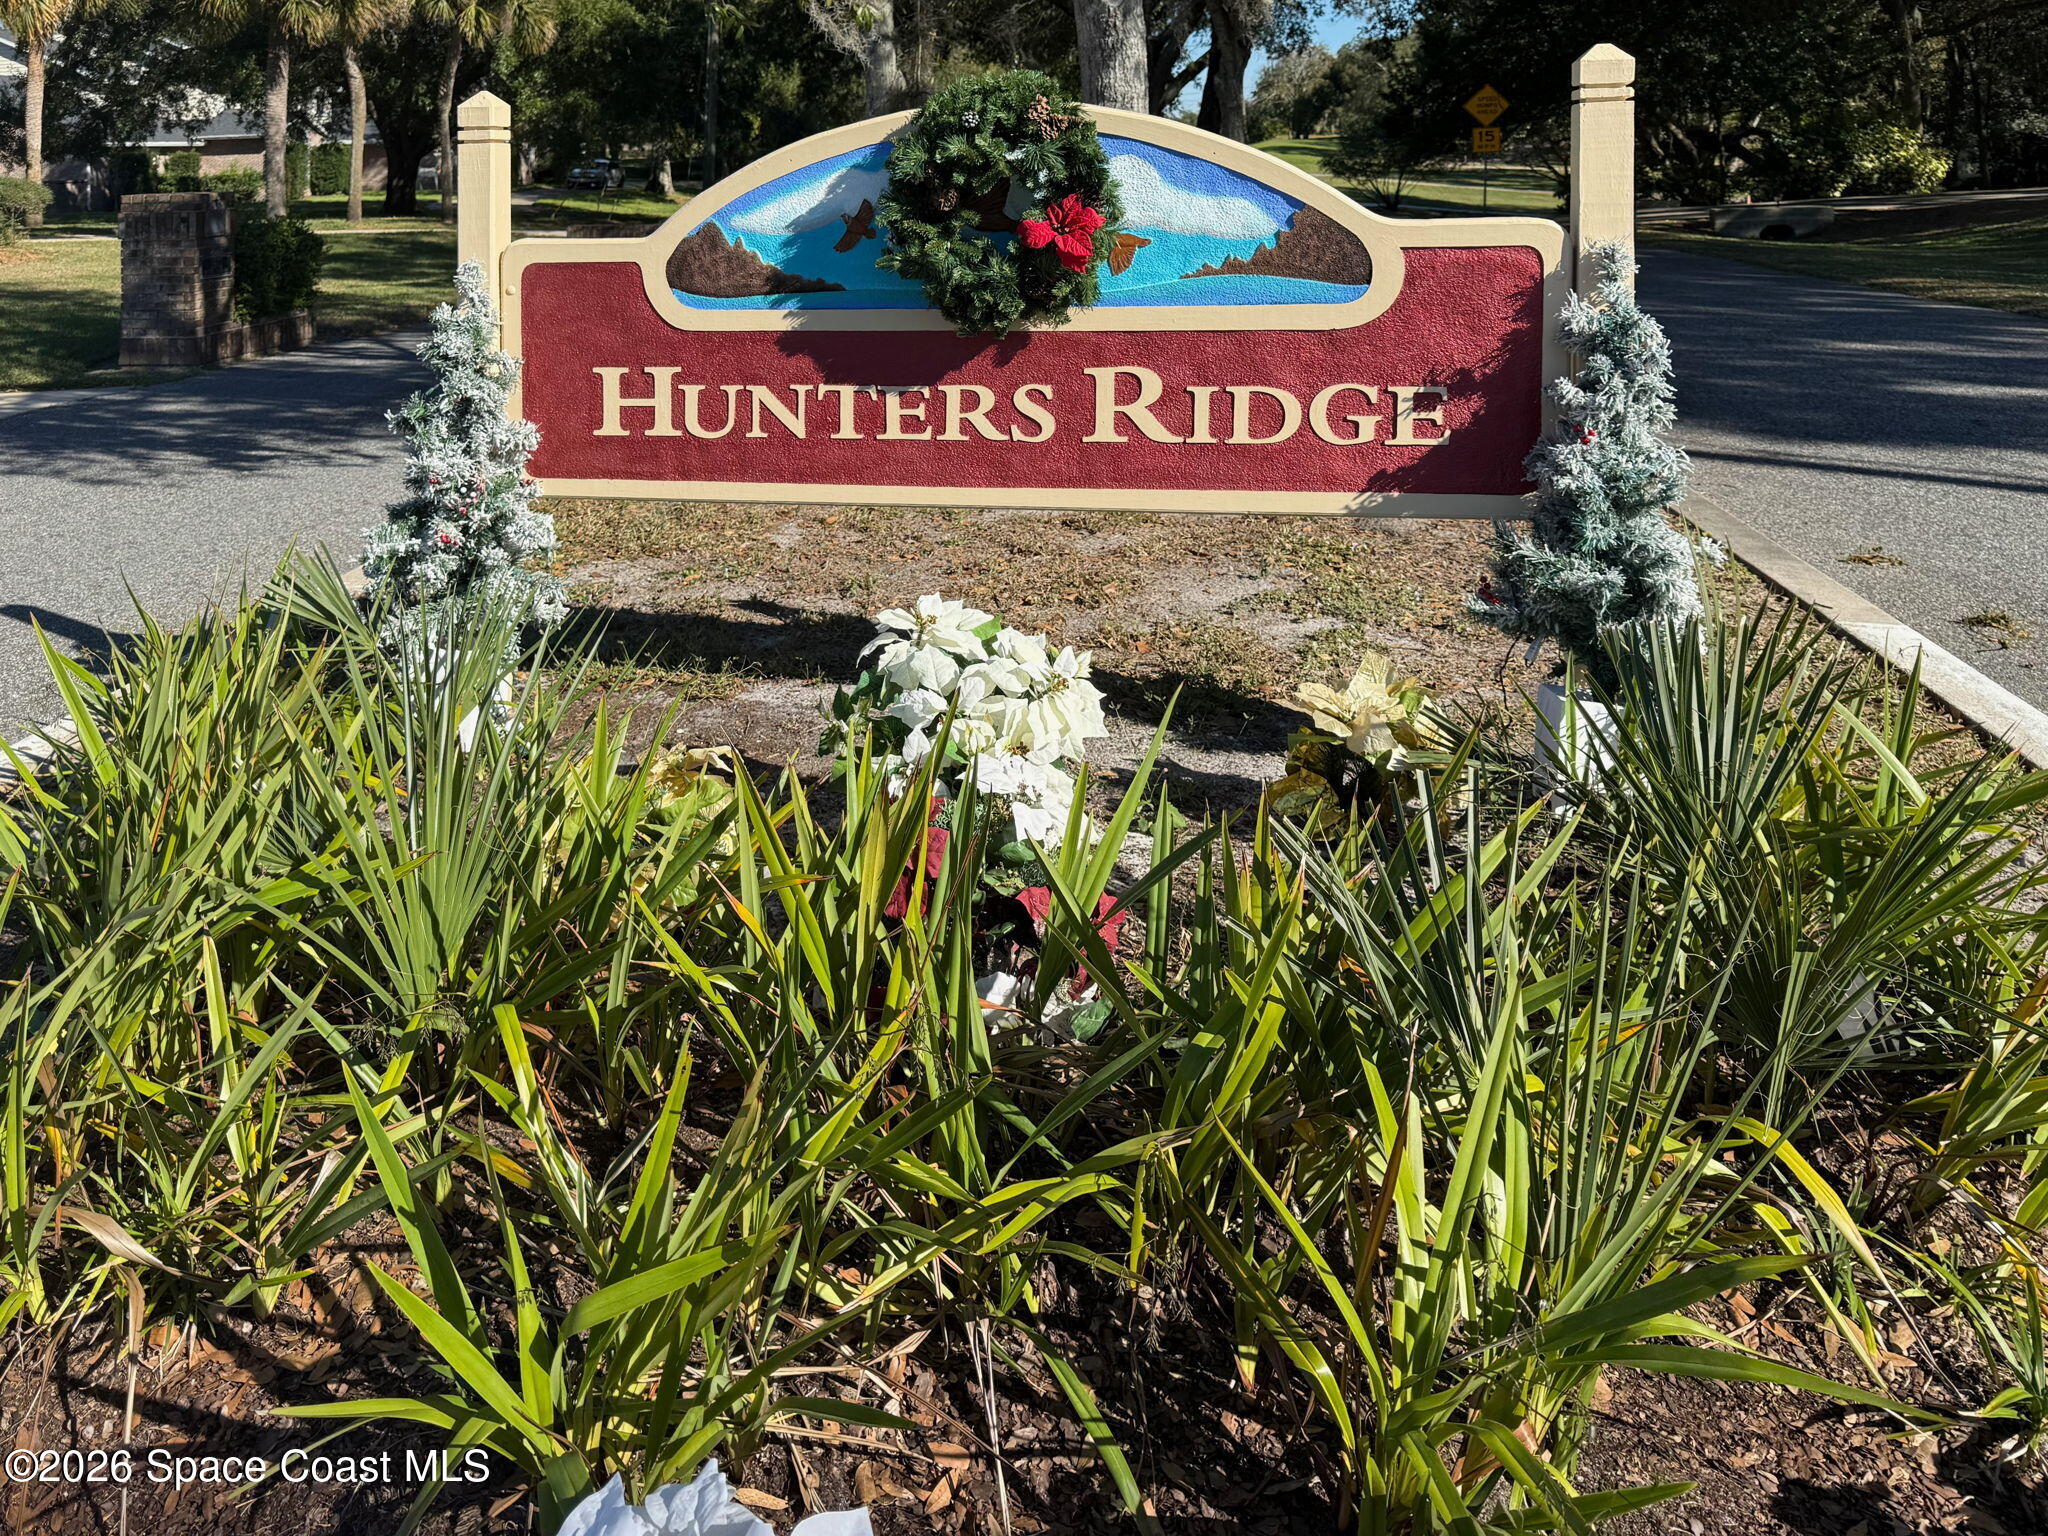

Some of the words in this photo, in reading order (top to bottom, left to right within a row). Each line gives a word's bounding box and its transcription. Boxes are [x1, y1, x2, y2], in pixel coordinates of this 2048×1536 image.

[1478, 130, 1495, 142] 15
[592, 366, 1056, 442] HUNTERS
[1081, 365, 1451, 446] RIDGE
